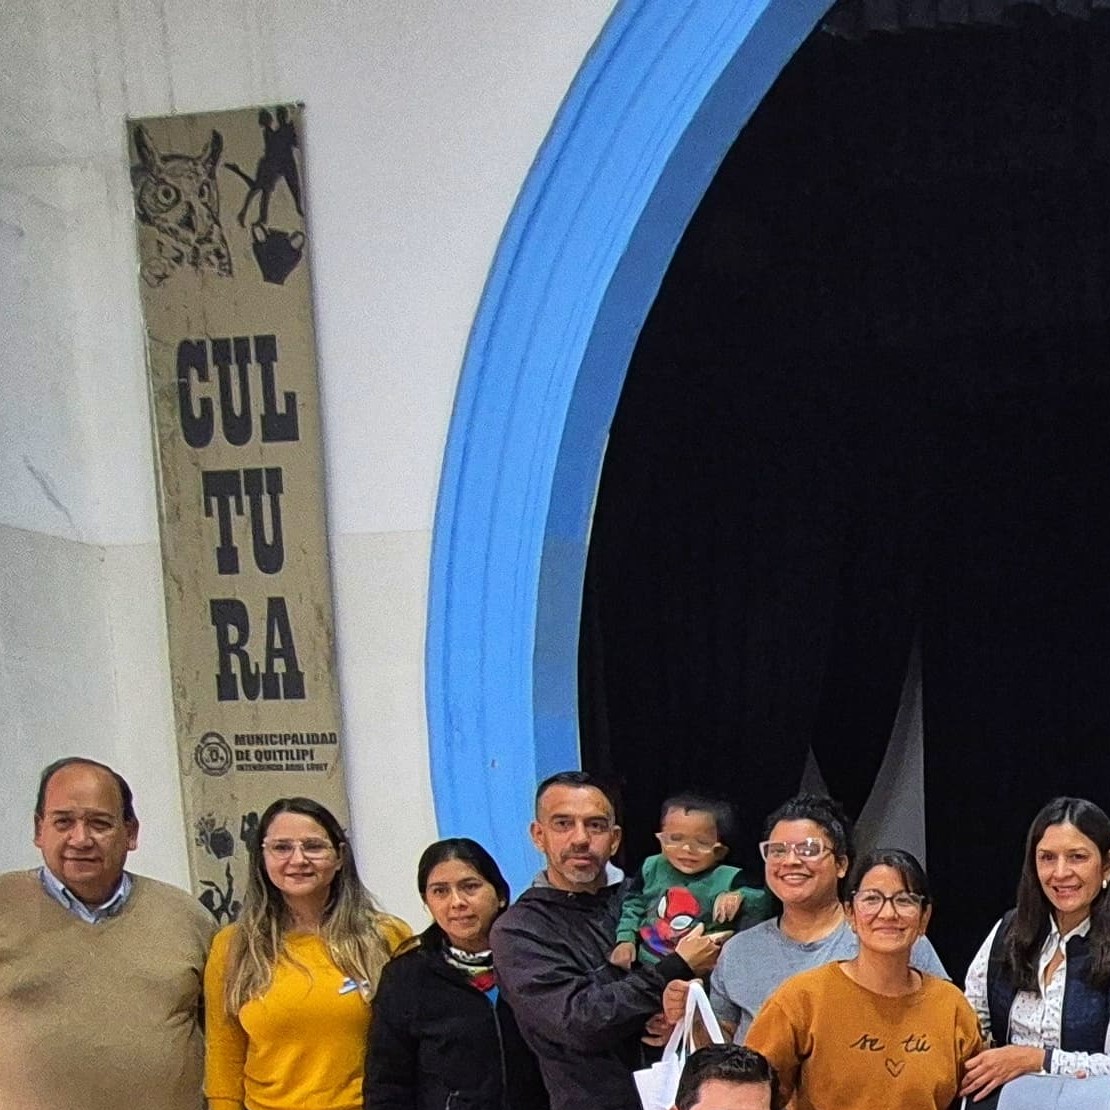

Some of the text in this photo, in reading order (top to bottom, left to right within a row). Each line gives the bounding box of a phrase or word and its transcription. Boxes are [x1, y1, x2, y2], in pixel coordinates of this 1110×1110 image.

[177, 335, 299, 448] CUL
[202, 467, 283, 575] TU
[210, 597, 305, 701] RA
[234, 732, 338, 746] MUNICIPALIDAD
[236, 749, 315, 762] DE QUITILIPI
